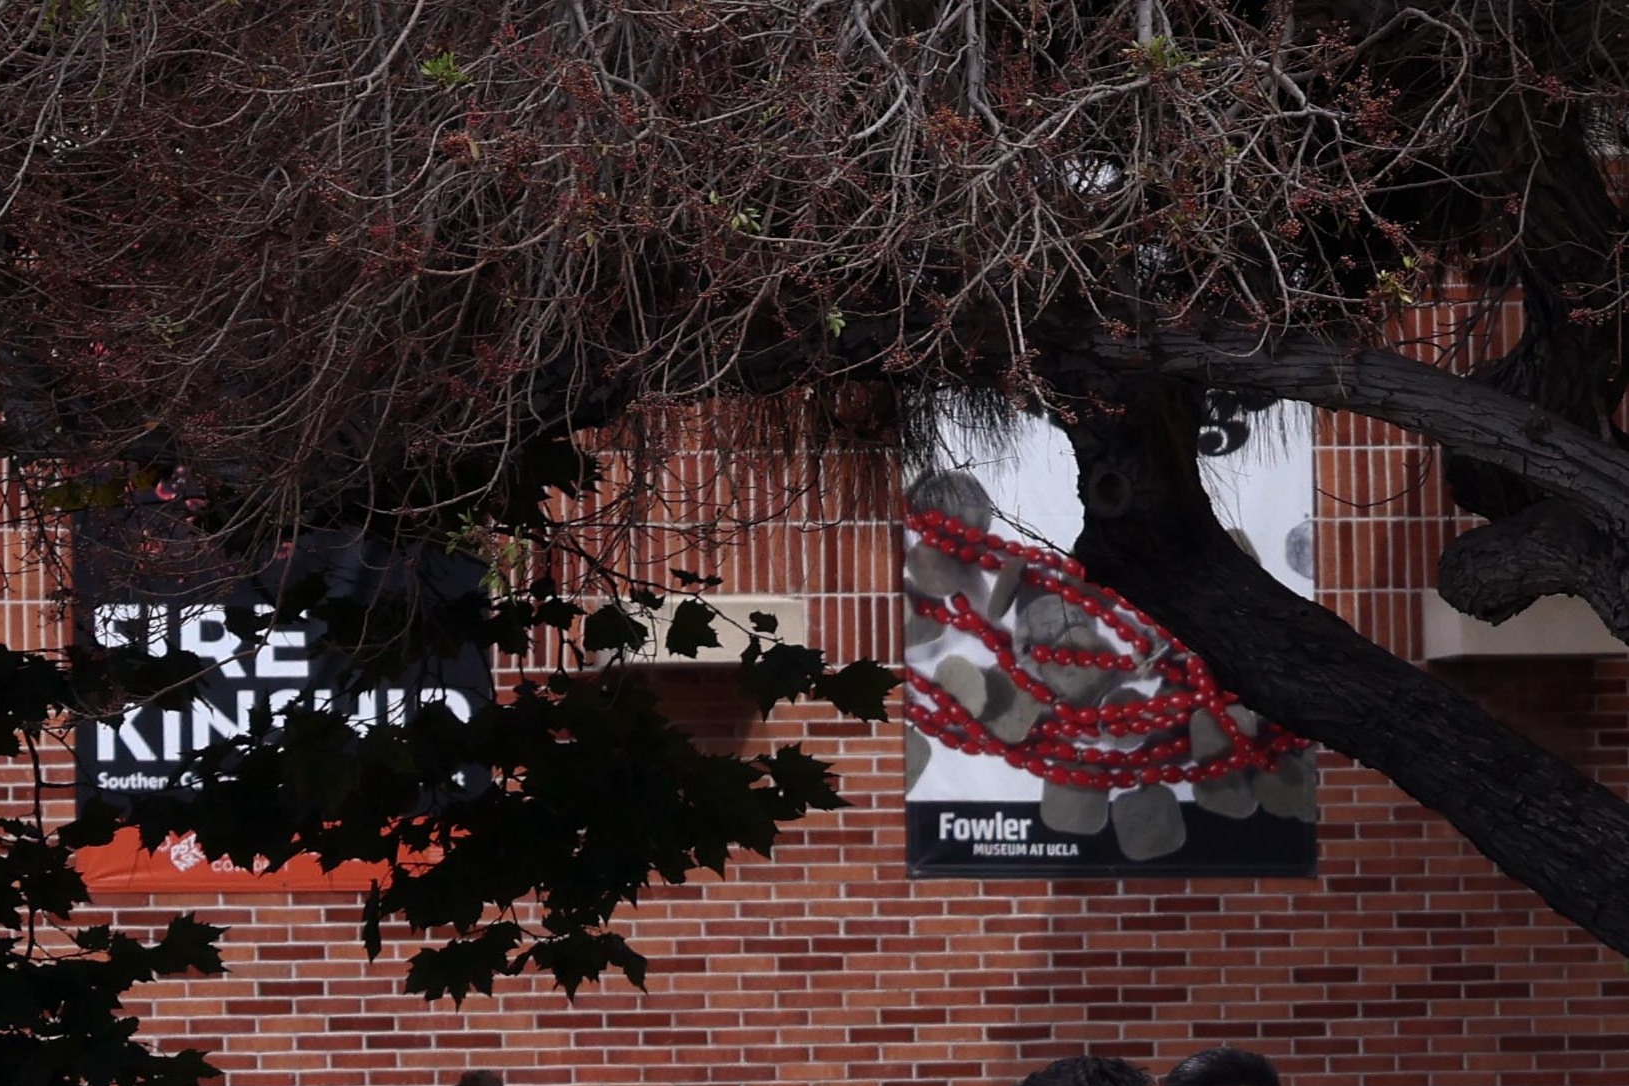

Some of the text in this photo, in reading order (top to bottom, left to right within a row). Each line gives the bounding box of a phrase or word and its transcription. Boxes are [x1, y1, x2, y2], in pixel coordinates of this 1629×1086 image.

[97, 771, 179, 790] Souther
[939, 811, 1032, 841] Fowler
[973, 843, 1079, 856] MUSEUM AT UCLA
